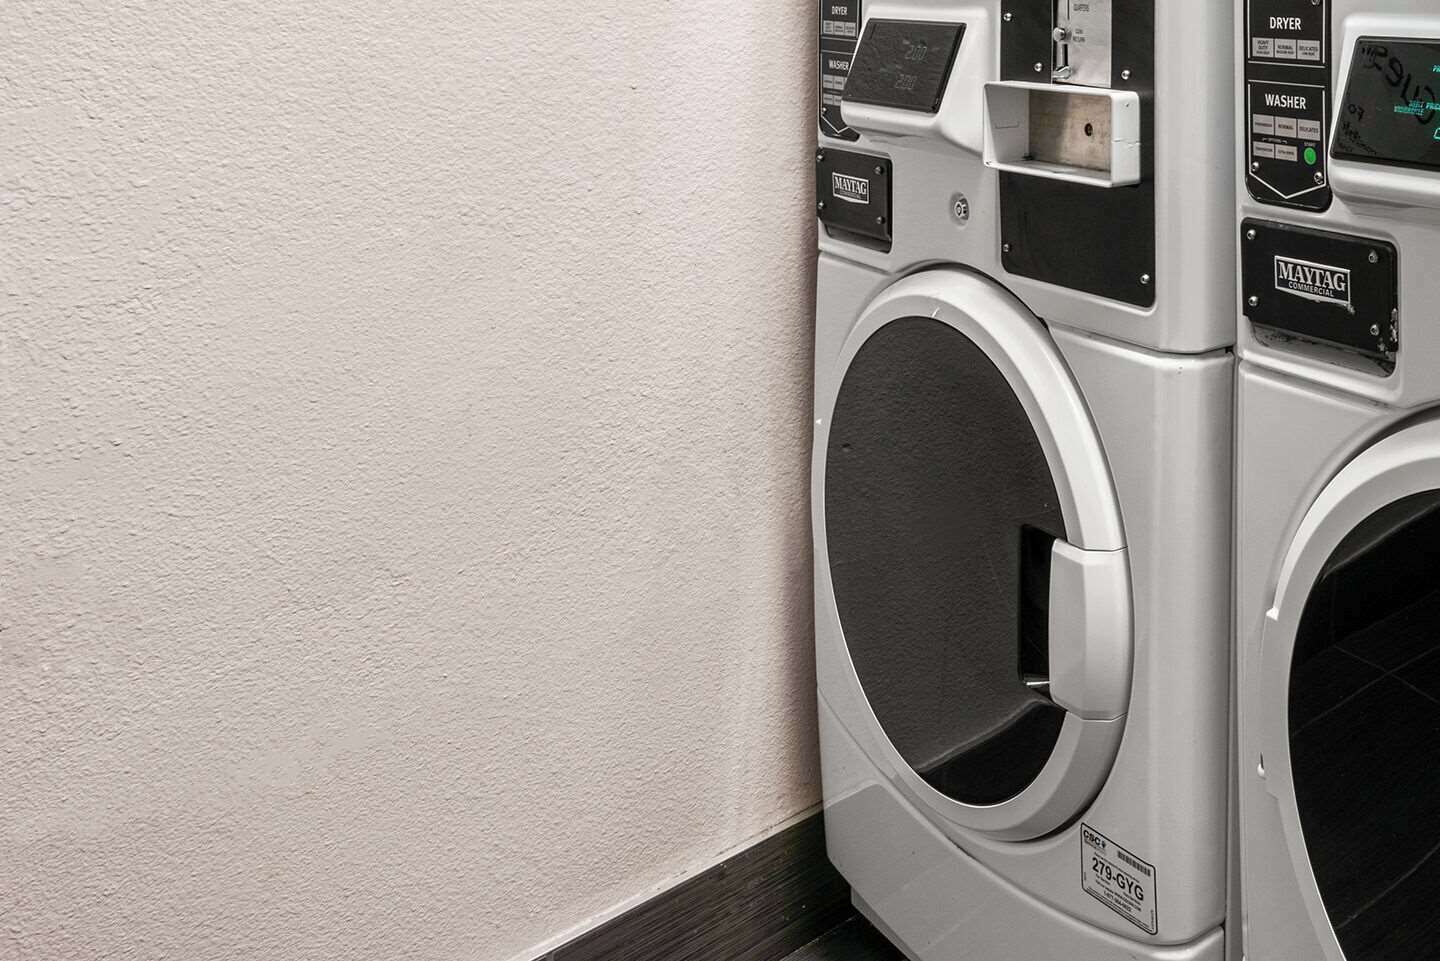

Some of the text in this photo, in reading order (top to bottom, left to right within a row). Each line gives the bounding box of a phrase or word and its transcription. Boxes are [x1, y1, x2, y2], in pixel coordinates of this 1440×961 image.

[1269, 16, 1302, 30] DRYER
[1264, 93, 1307, 110] WASHER
[834, 176, 867, 195] MAYTAG
[1278, 261, 1347, 292] MAYTAG
[1288, 281, 1335, 298] COMMERCIAL
[1091, 857, 1145, 901] 279-GYG
